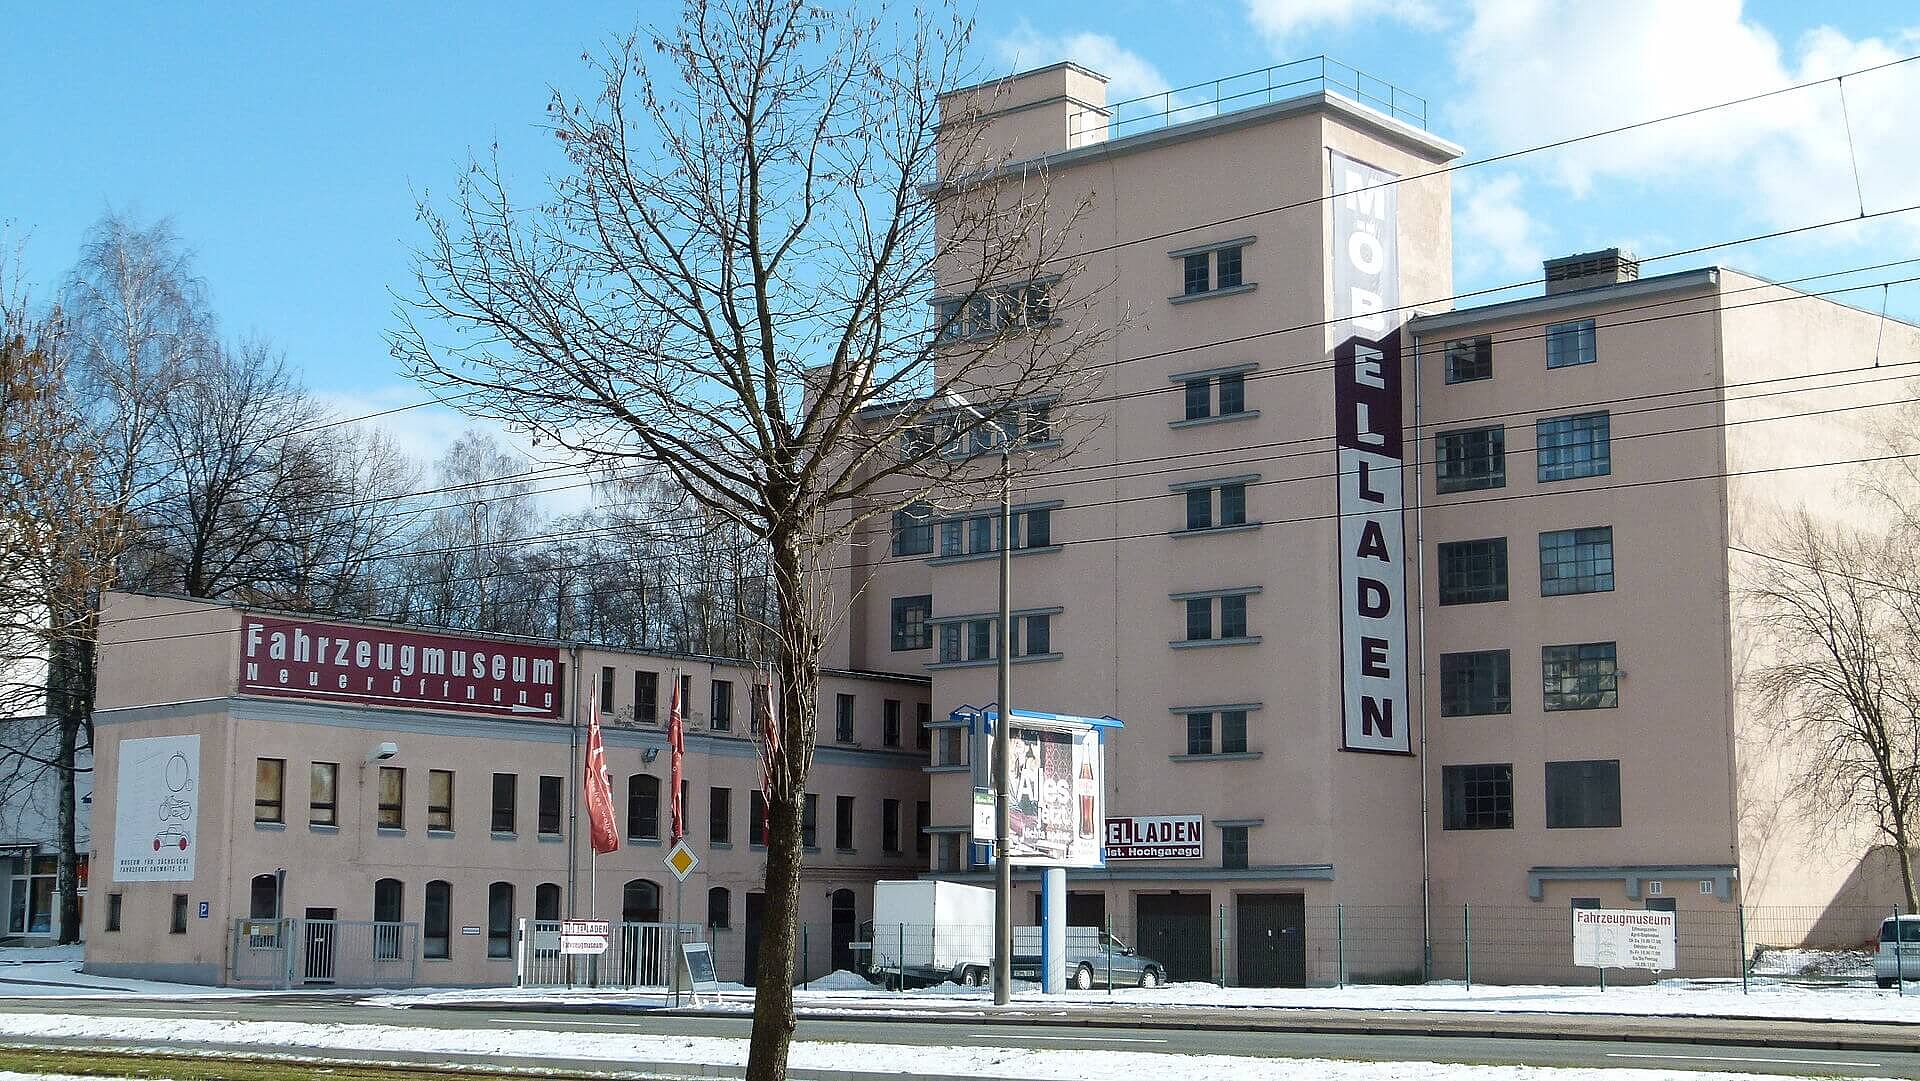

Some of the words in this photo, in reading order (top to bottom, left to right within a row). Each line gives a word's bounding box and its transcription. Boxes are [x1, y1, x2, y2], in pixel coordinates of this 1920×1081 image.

[247, 623, 554, 685] Fahrzeugmuseum
[246, 662, 553, 708] Neueröffnung
[1017, 768, 1071, 803] Alles
[1128, 847, 1200, 858] Hochgarage
[1577, 911, 1671, 926] Fahrzeugmuseum
